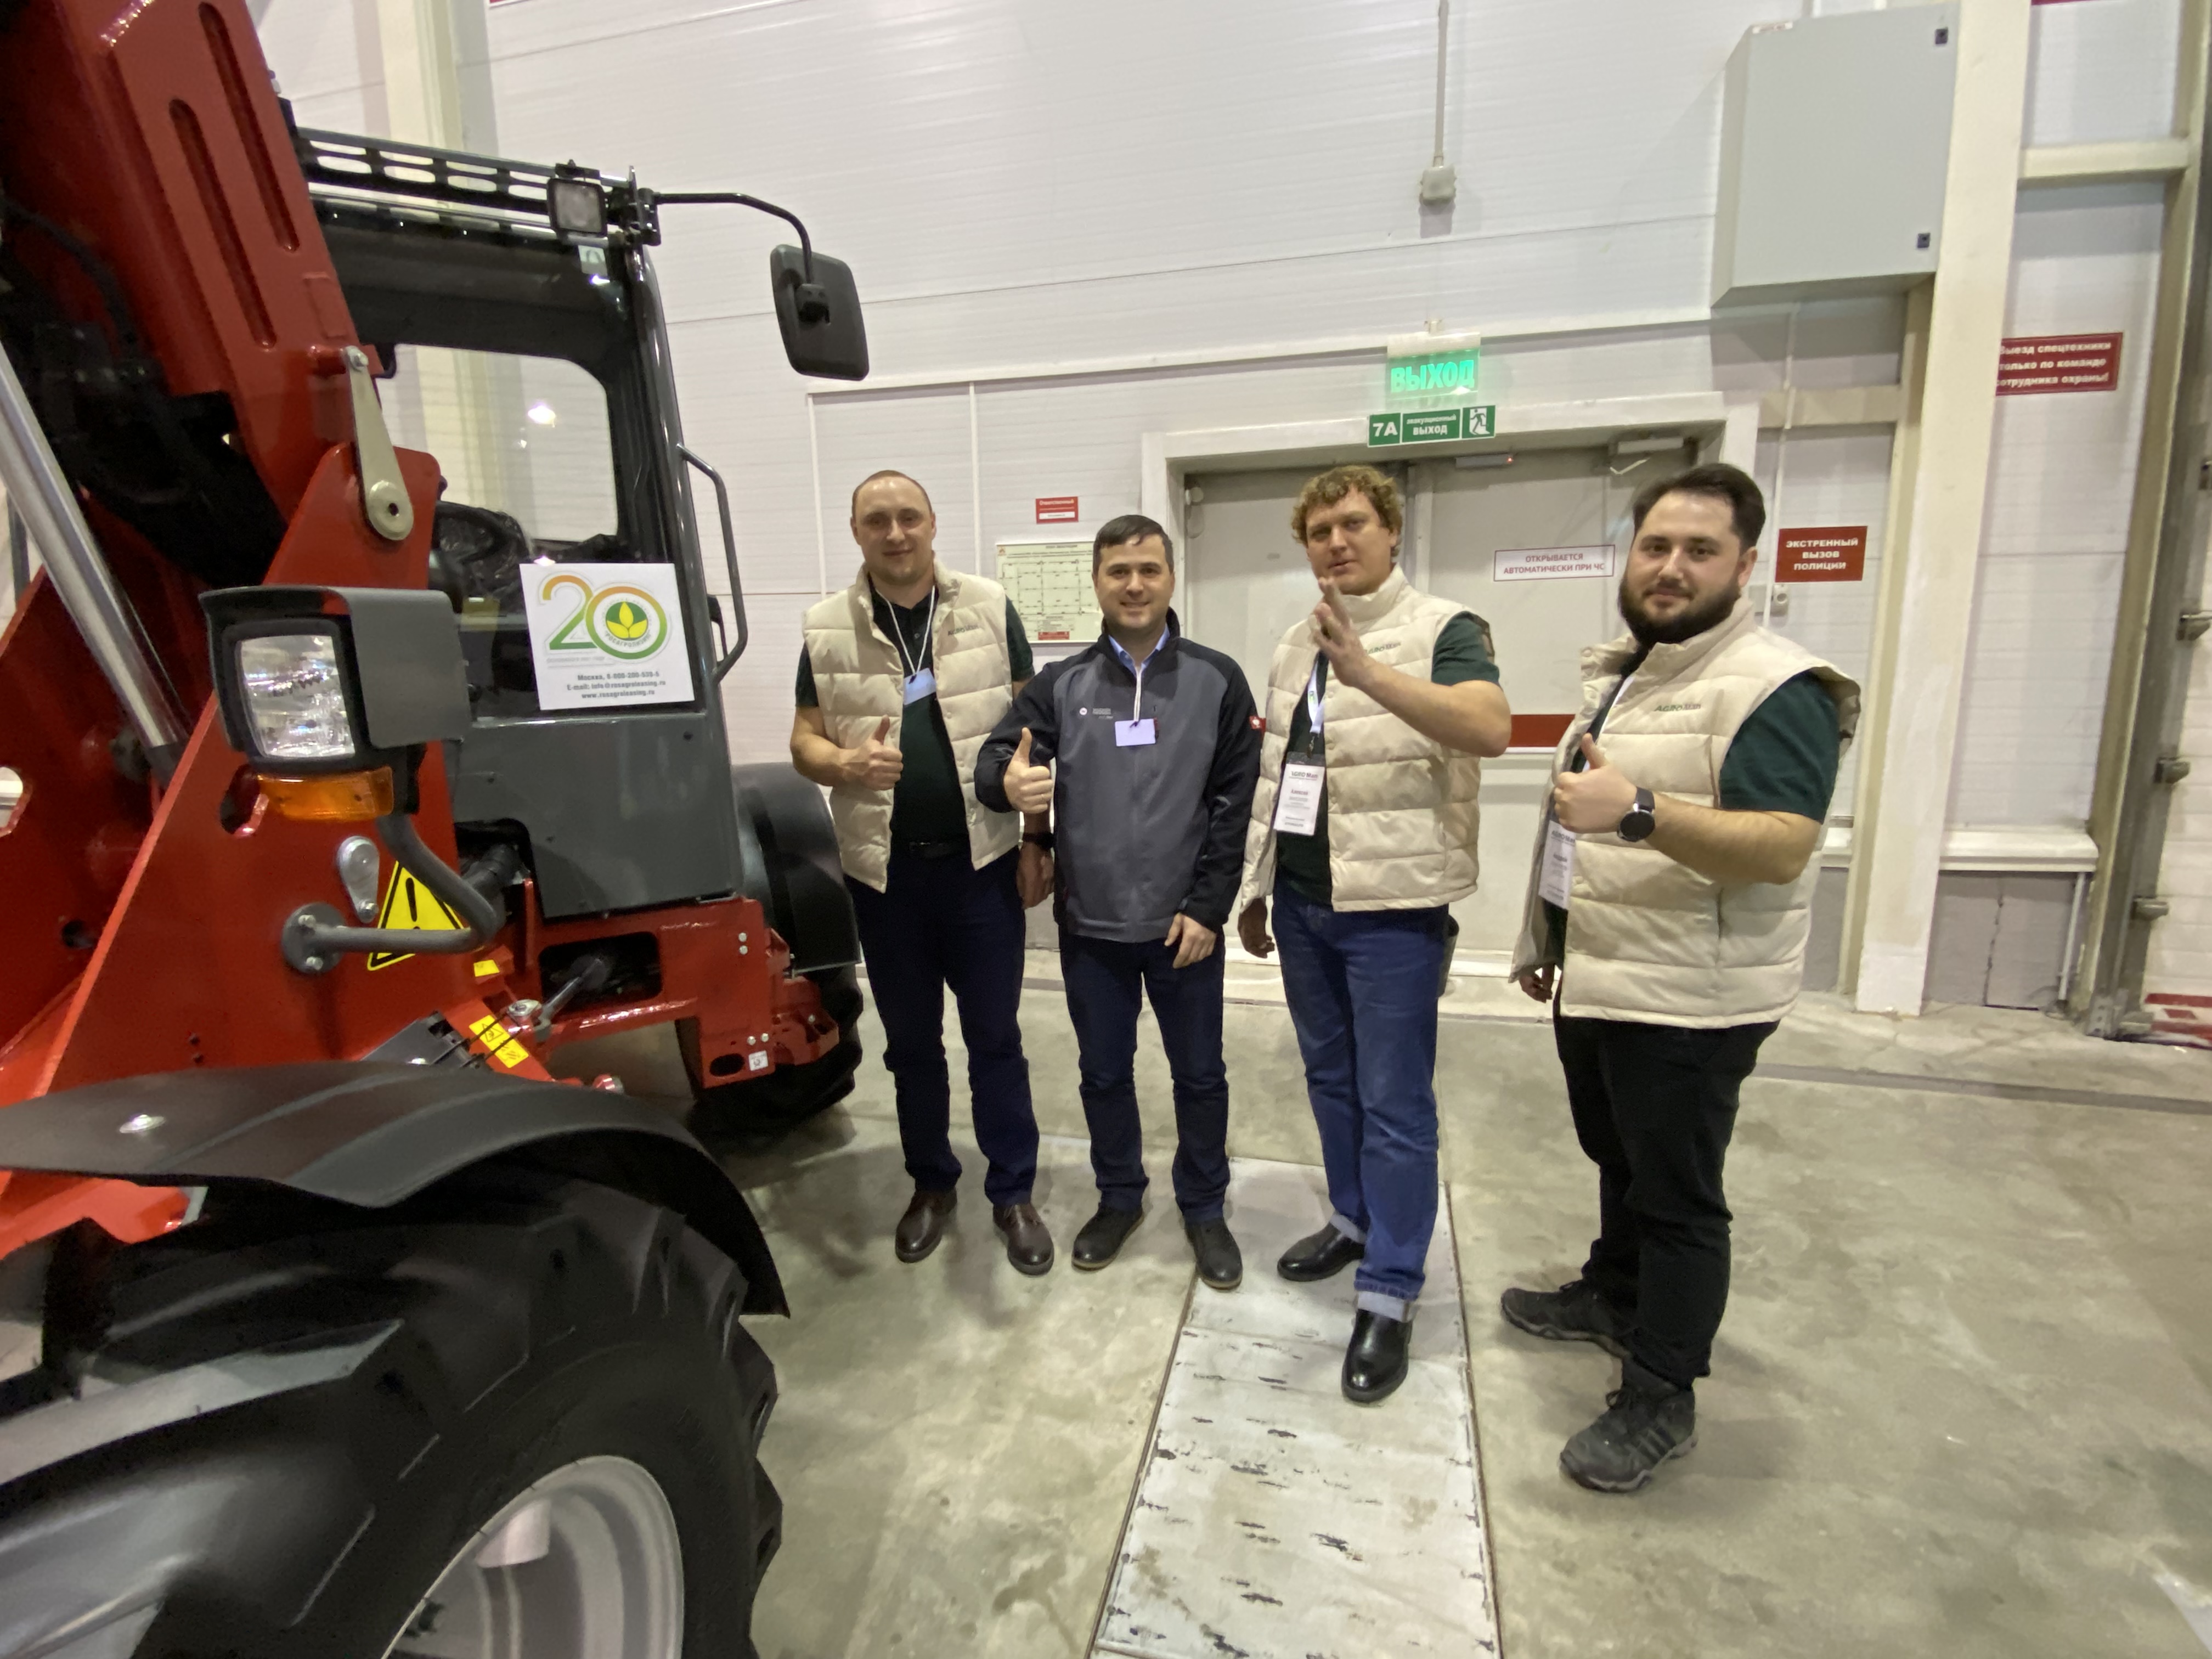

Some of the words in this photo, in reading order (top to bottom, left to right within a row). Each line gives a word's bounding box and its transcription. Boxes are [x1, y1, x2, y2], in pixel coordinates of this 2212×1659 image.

[2037, 342, 2111, 353] спецтехники
[2057, 358, 2107, 368] команде
[1391, 359, 1475, 392] ВЫХОД
[1373, 421, 1398, 437] 7А
[1413, 425, 1448, 436] ВЫХОД
[1786, 538, 1859, 548] ЭКСТРЕННЫЙ
[1525, 553, 1584, 563] ОТКРЫВАЕТСЯ
[1503, 564, 1573, 574] АВТОМАТИЧЕСКИ
[1594, 562, 1605, 571] ЧС
[1794, 562, 1847, 571] ПОЛИЦИИ
[543, 574, 668, 660] 20
